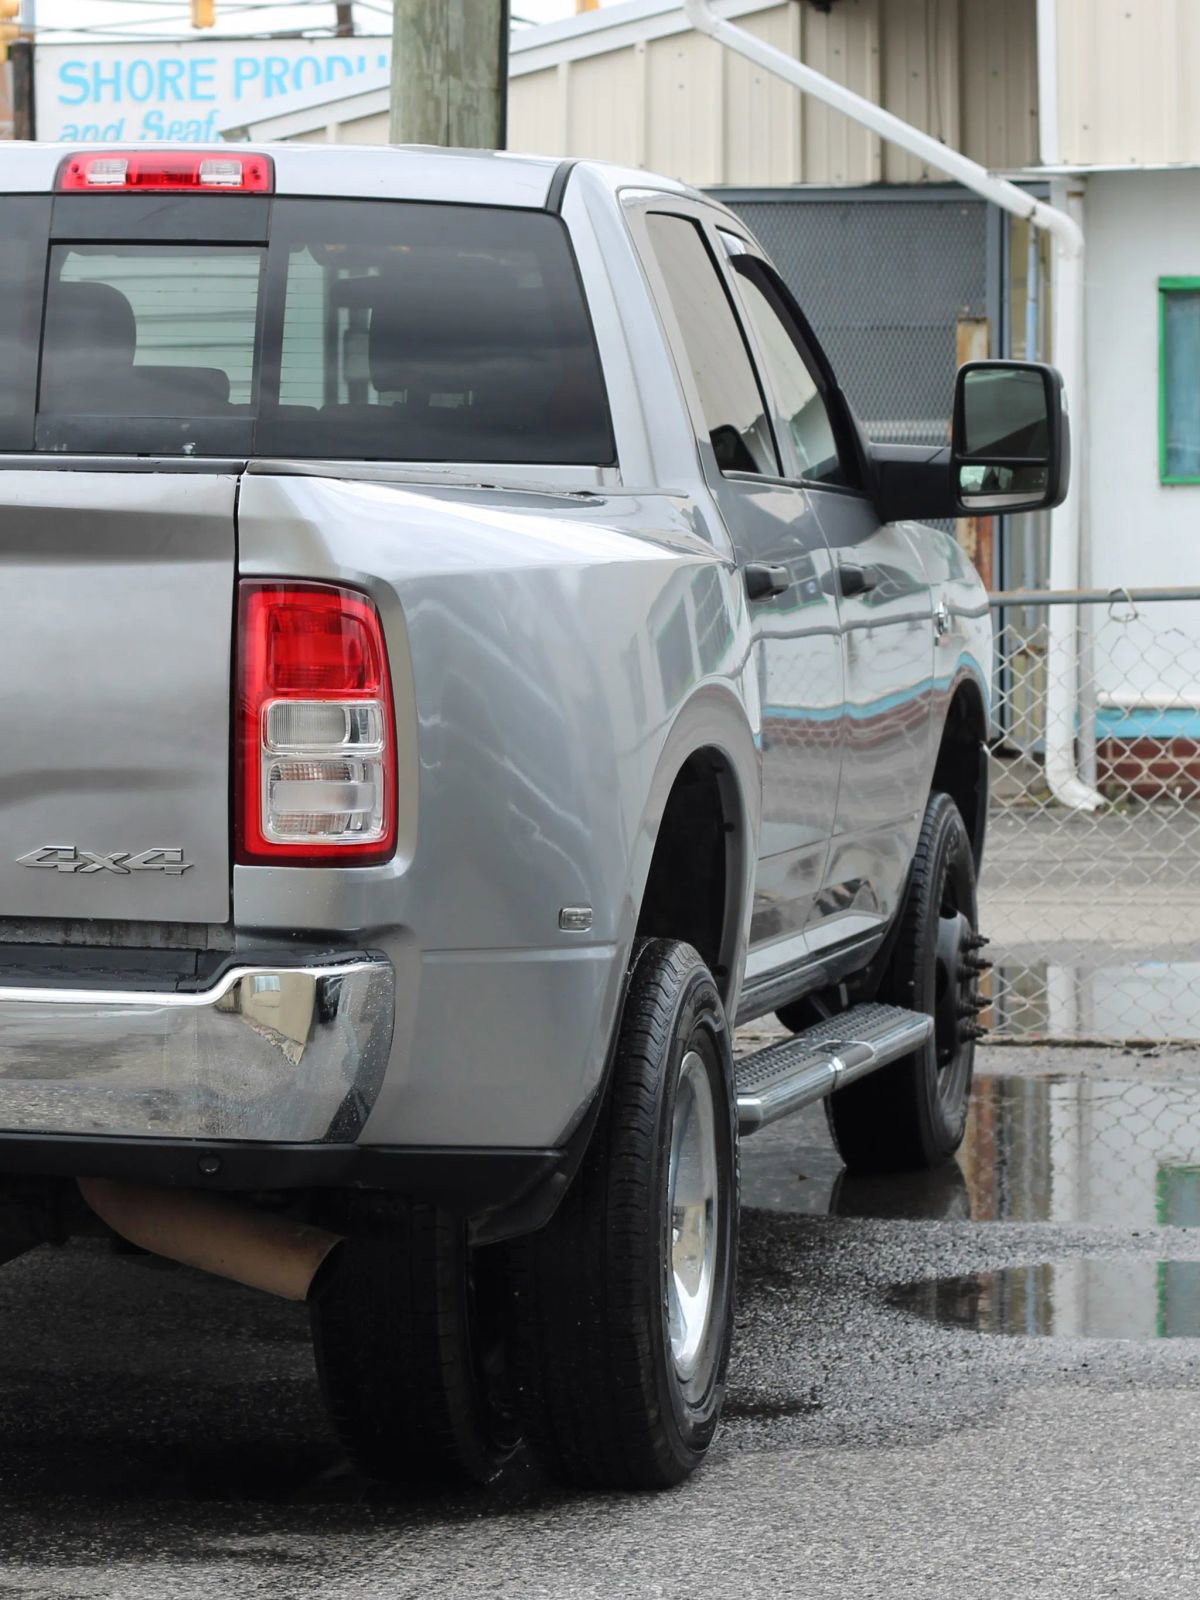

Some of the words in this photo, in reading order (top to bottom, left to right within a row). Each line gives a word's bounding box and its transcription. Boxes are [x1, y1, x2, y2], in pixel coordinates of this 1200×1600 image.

[58, 58, 217, 105] SHORE
[59, 117, 125, 142] and
[139, 107, 221, 143] Seaf
